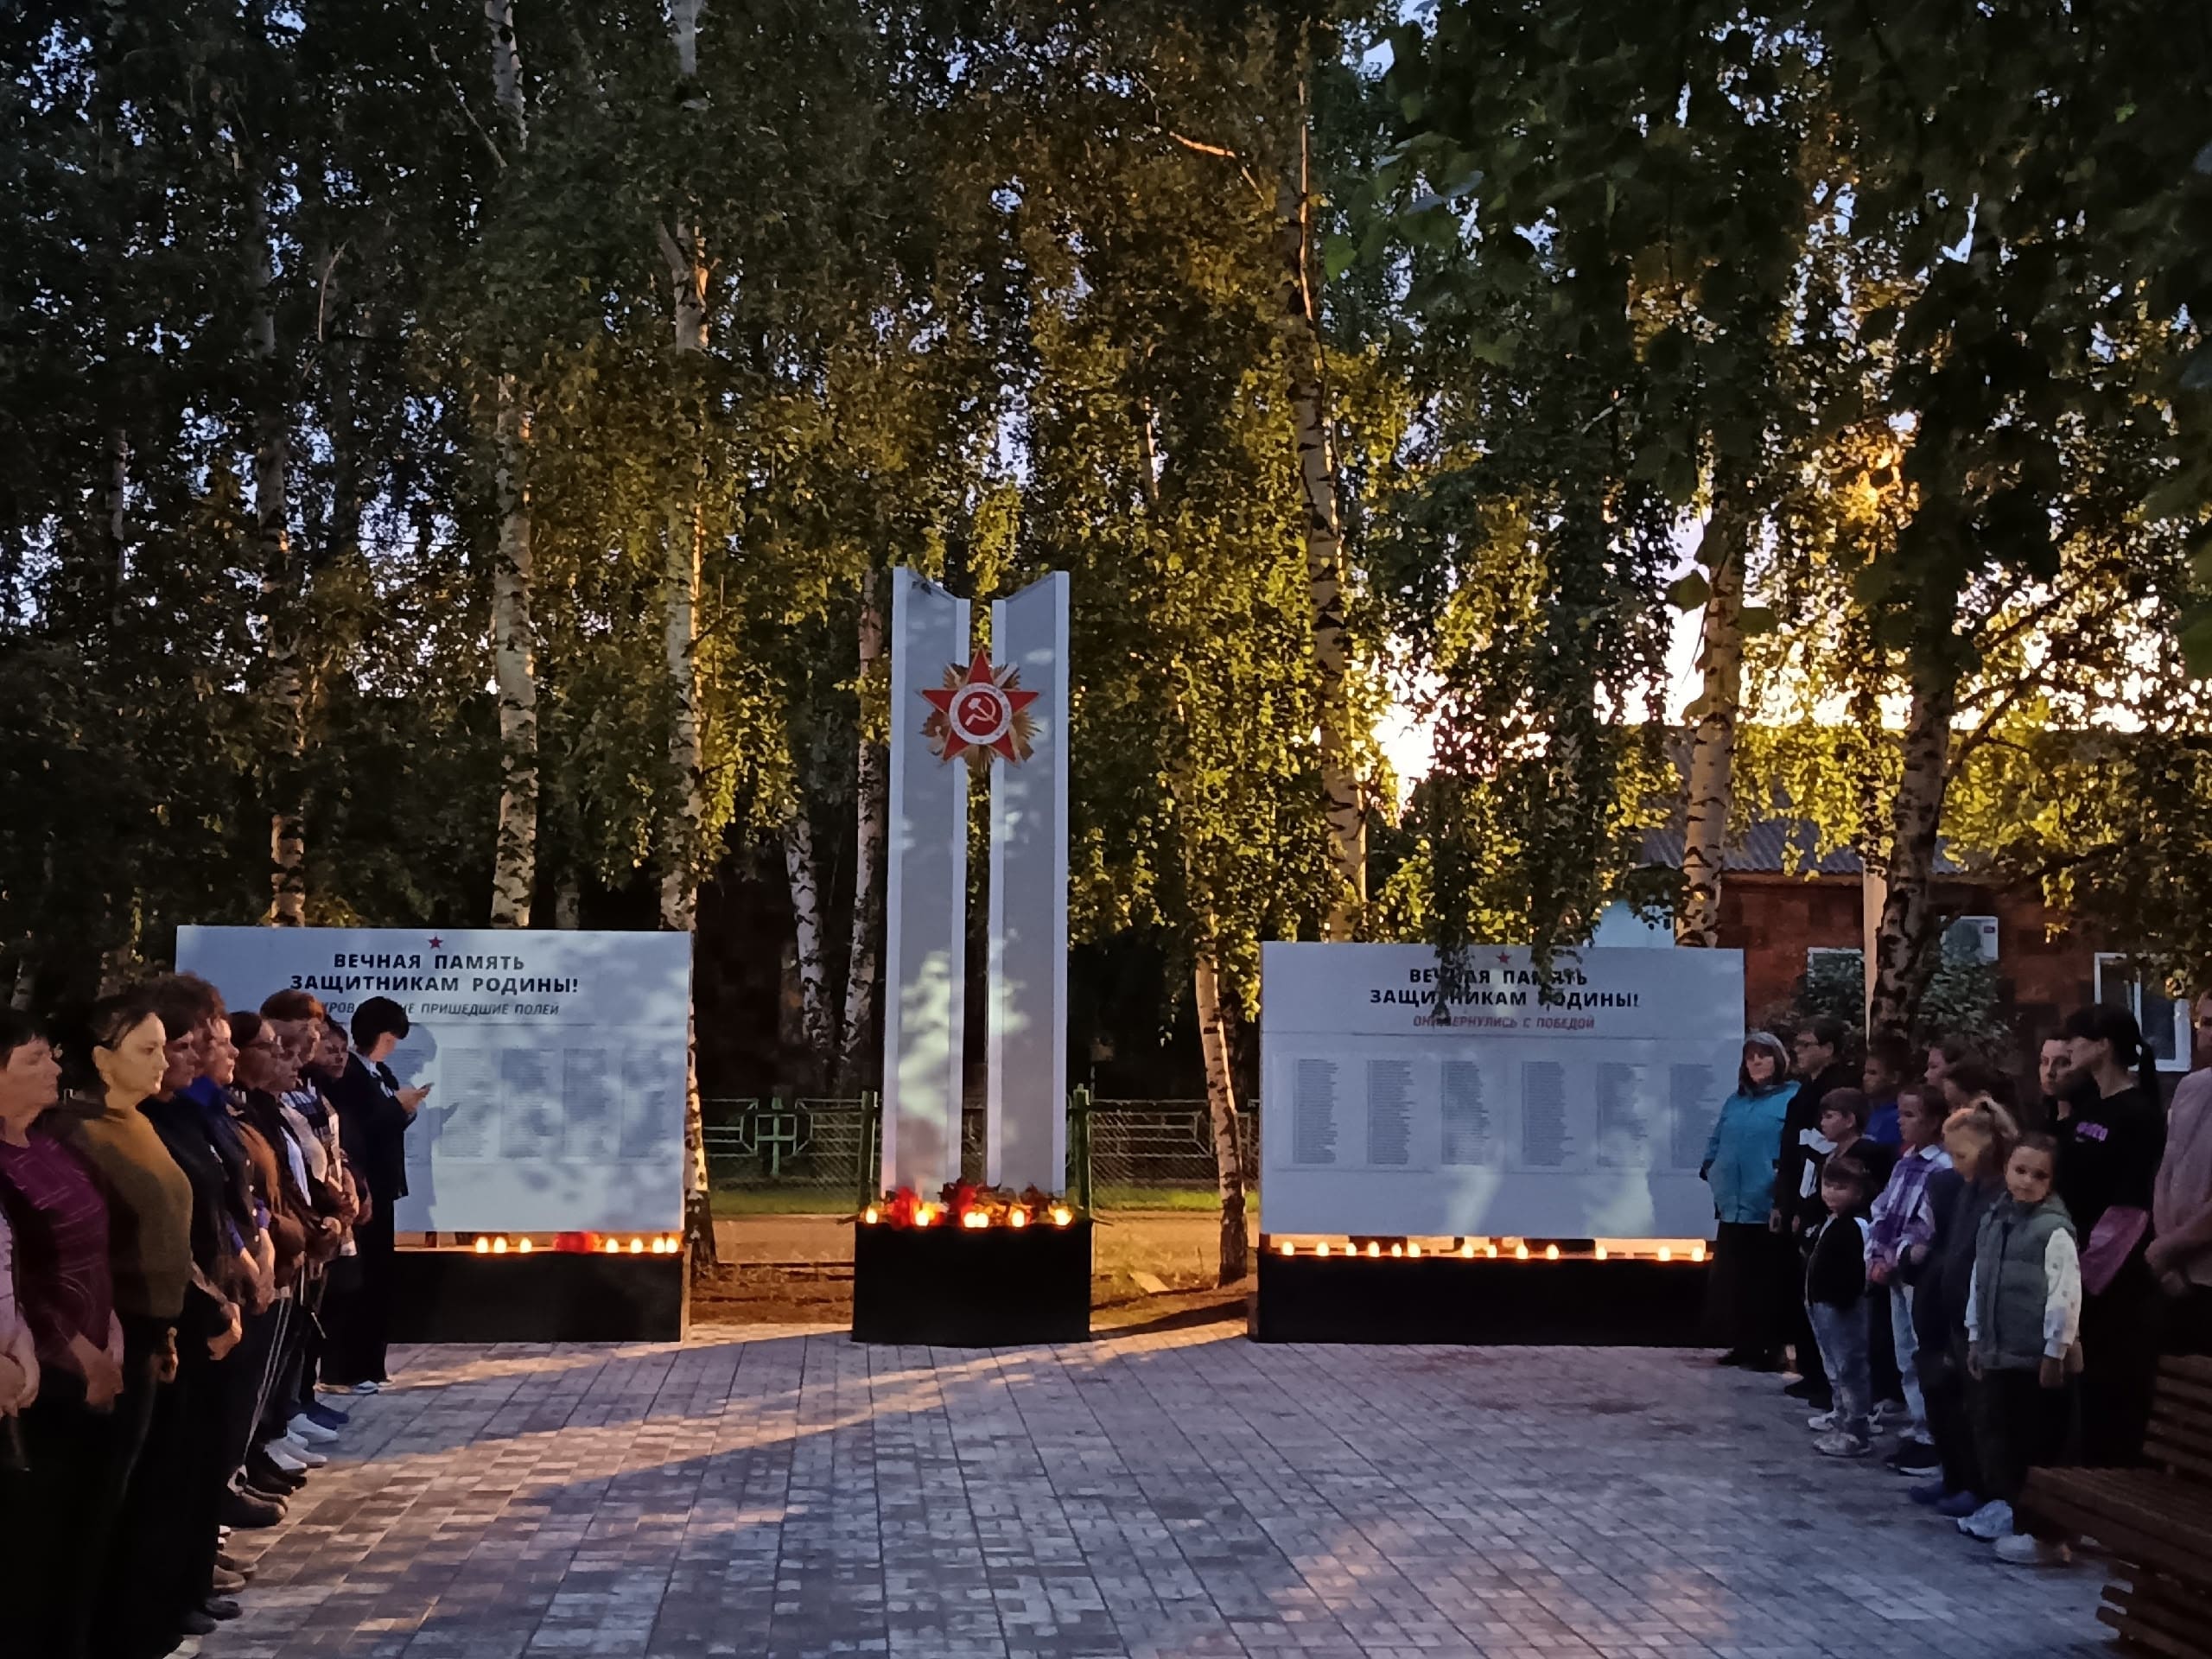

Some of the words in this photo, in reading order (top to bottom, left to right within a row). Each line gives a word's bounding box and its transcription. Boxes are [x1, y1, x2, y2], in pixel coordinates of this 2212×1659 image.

[334, 954, 421, 969] ВЕЧНАЯ
[435, 955, 524, 969] ПАМЯТЬ
[1409, 969, 1491, 983] ВЕАЯ
[290, 976, 459, 993] ЗАЩИТНИКАМ
[473, 977, 578, 995] РОДИНЫ!
[1370, 989, 1527, 1007] ЗАЩИНИКАМ
[1539, 991, 1640, 1010] ОДИНЫ!
[421, 1003, 509, 1016] ПРИШЕДШИЕ
[514, 1002, 560, 1015] ПОЛЕЙ
[1446, 1015, 1517, 1028] ЕРНУЛИСЬ
[1523, 1017, 1531, 1028] С
[1536, 1015, 1596, 1030] ПОБЕДОЙ
